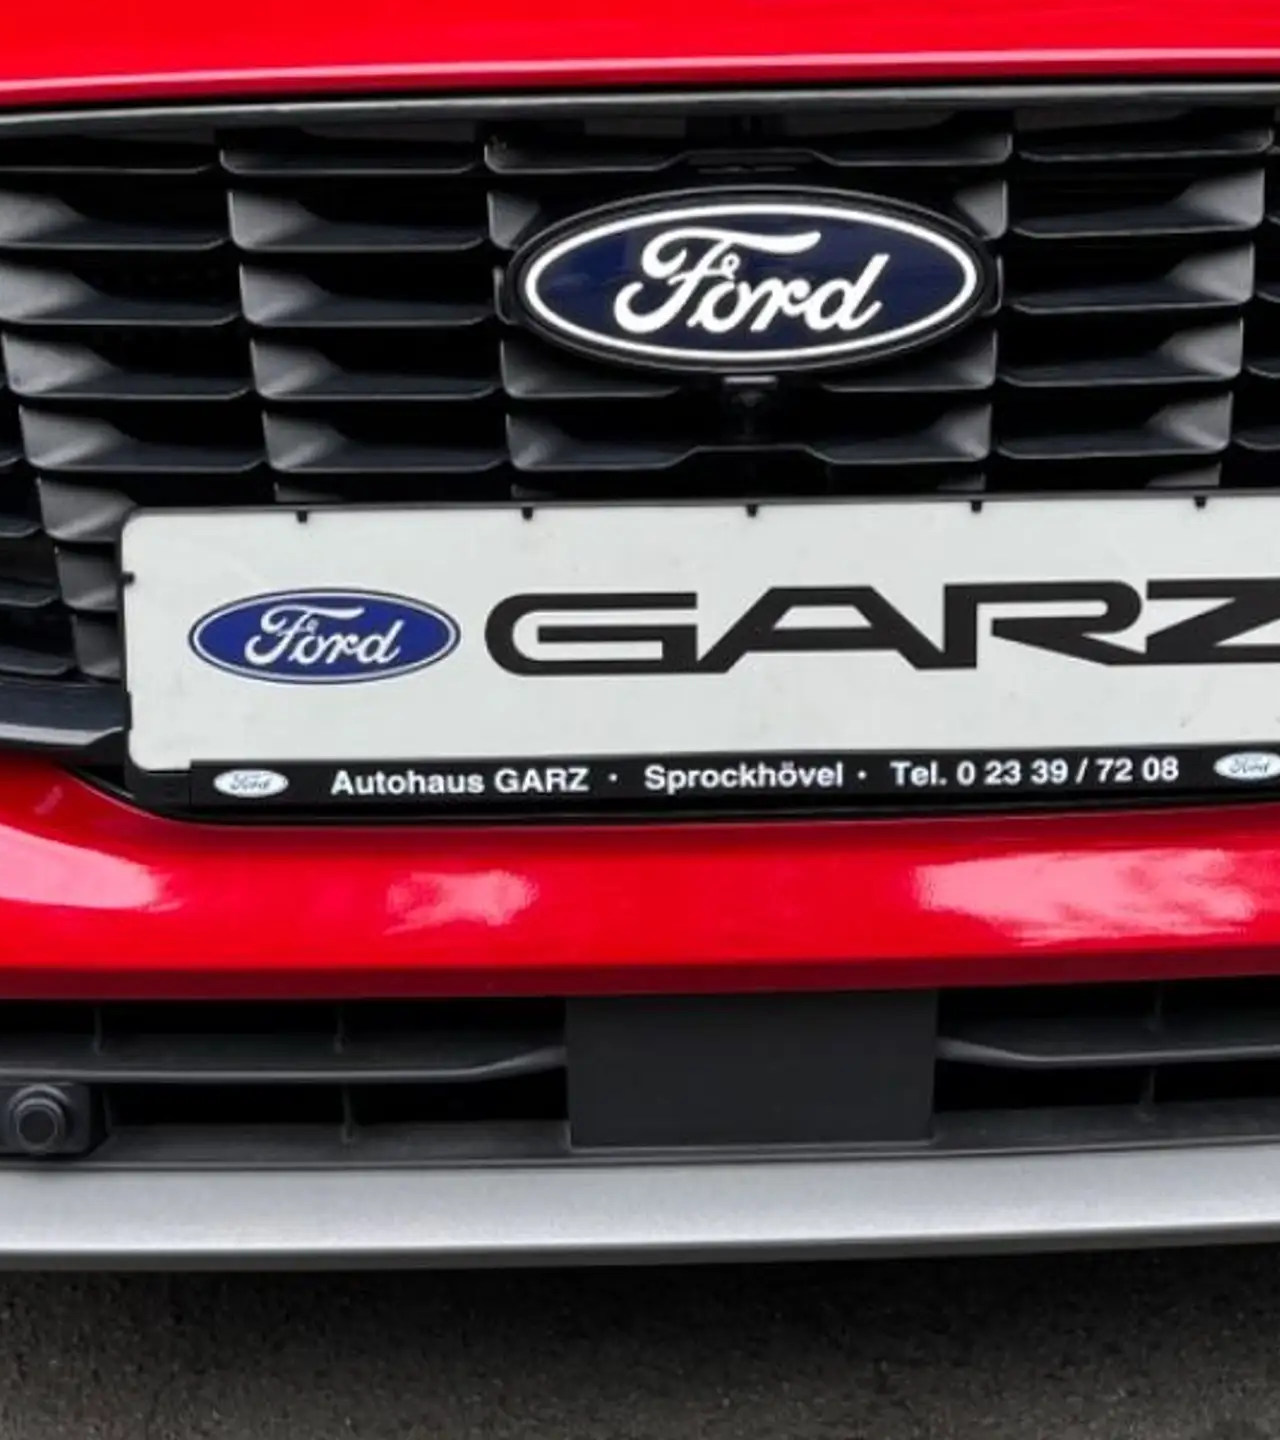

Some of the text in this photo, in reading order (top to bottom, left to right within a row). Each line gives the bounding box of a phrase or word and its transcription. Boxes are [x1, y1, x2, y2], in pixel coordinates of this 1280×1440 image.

[613, 226, 890, 334] Ford
[243, 603, 405, 667] Ford
[330, 769, 484, 796] Autohaus
[493, 767, 590, 794] GARZ
[644, 761, 843, 795] Sprockhövel
[890, 761, 947, 787] Tel.
[956, 761, 976, 786] 0
[984, 760, 1021, 786] 23
[1031, 759, 1068, 785] 39
[1097, 758, 1133, 783] 72
[1142, 756, 1180, 782] 08
